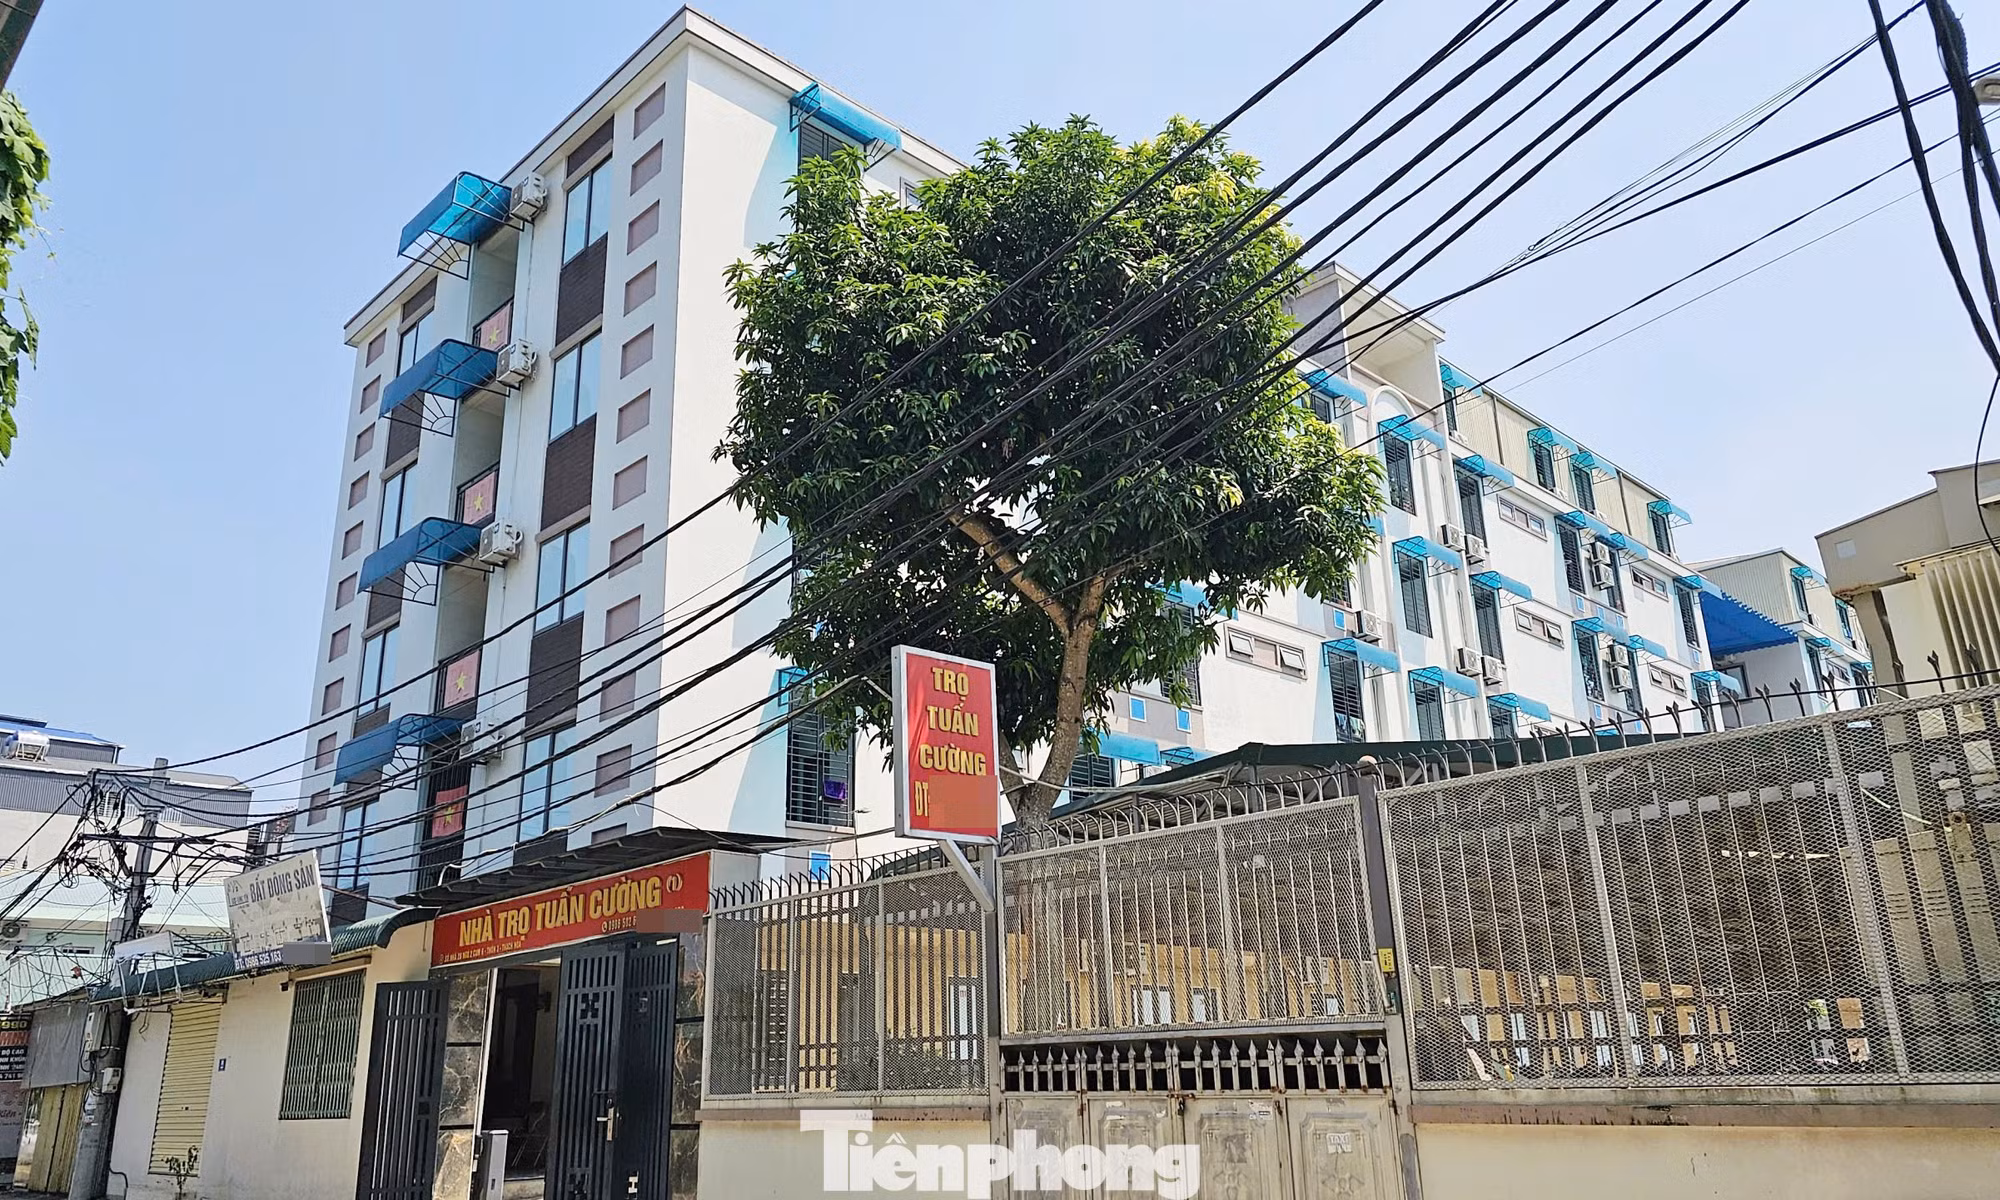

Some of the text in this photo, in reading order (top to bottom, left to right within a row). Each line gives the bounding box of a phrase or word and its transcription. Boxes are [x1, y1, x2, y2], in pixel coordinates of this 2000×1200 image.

[931, 667, 969, 703] TRỌ
[927, 702, 980, 737] TUẤN
[919, 743, 987, 776] CƯỜNG
[249, 874, 266, 903] BẤT
[267, 872, 293, 901] ĐỘNG
[293, 860, 315, 890] SẢN
[459, 873, 683, 947] NHÀ TRỌ TUẤN CƯỜNG (1)
